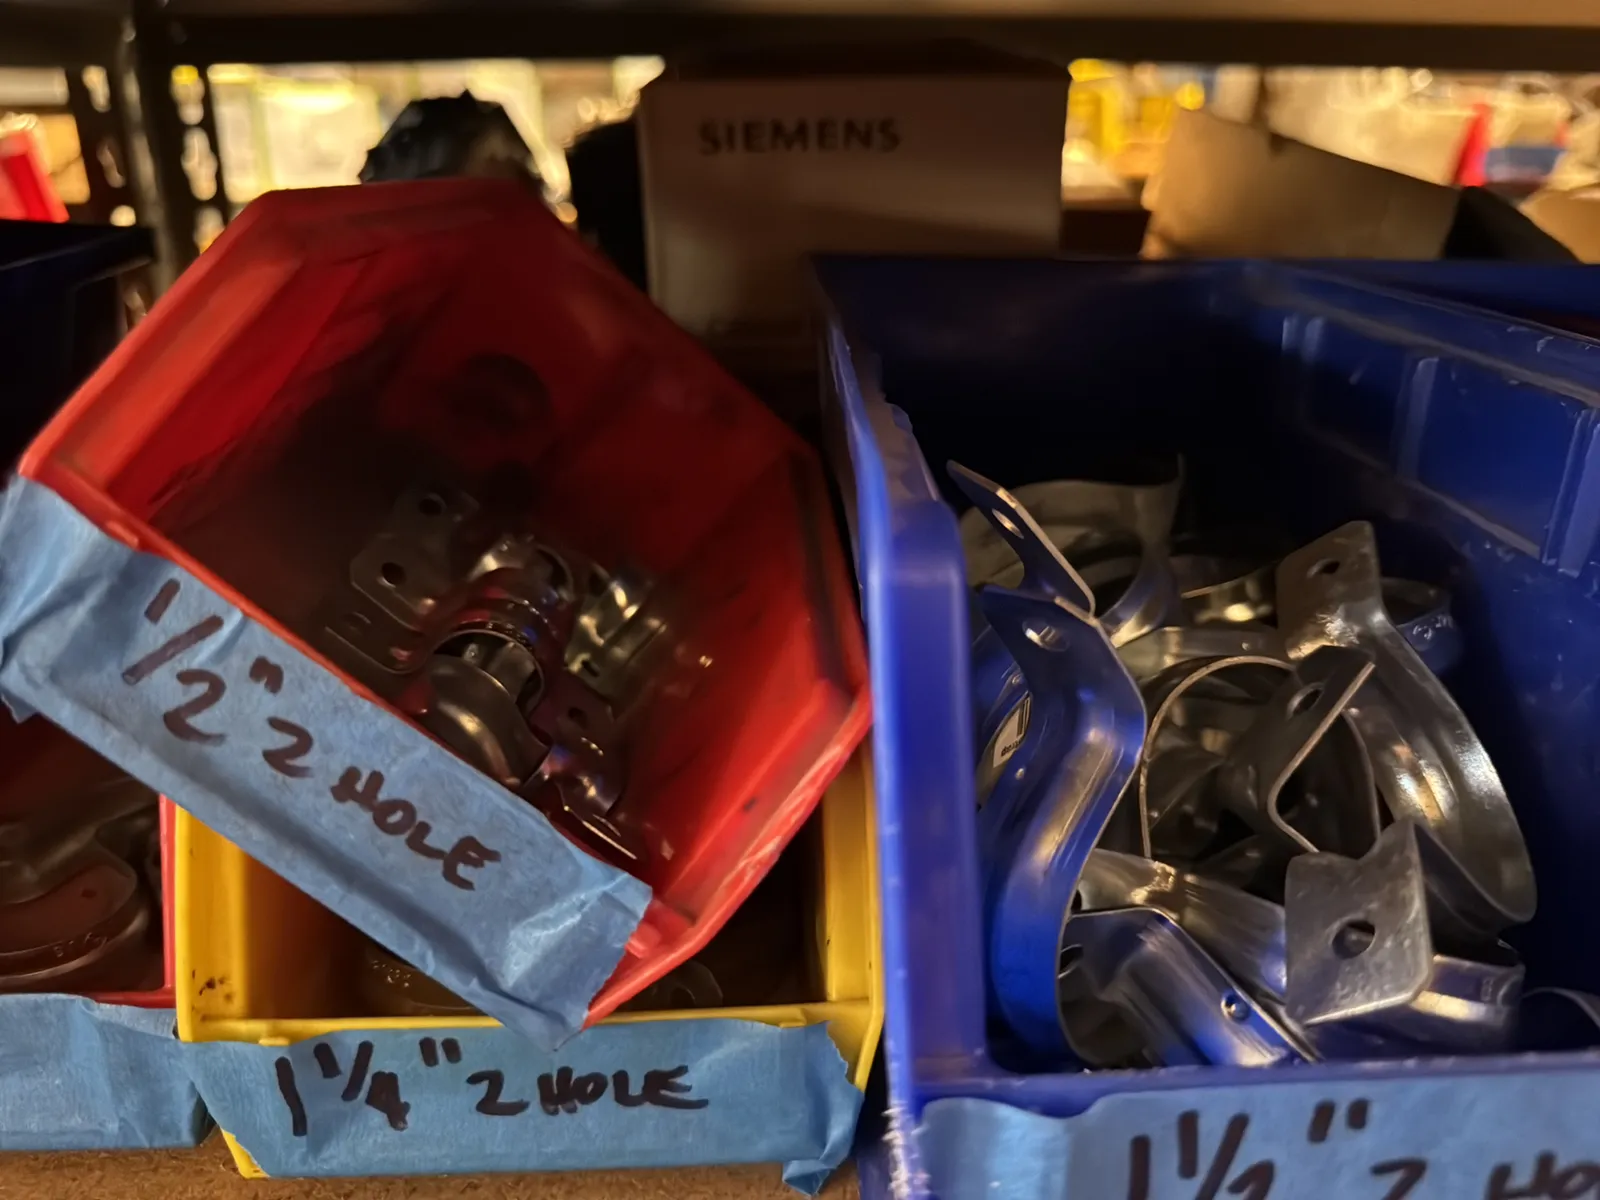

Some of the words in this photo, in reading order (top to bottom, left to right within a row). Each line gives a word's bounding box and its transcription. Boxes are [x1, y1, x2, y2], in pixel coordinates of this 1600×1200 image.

[698, 117, 902, 155] SIEMENS
[262, 716, 314, 778] 2
[330, 766, 502, 891] HOLE
[465, 1069, 530, 1116] 2
[537, 1064, 709, 1116] HOLE
